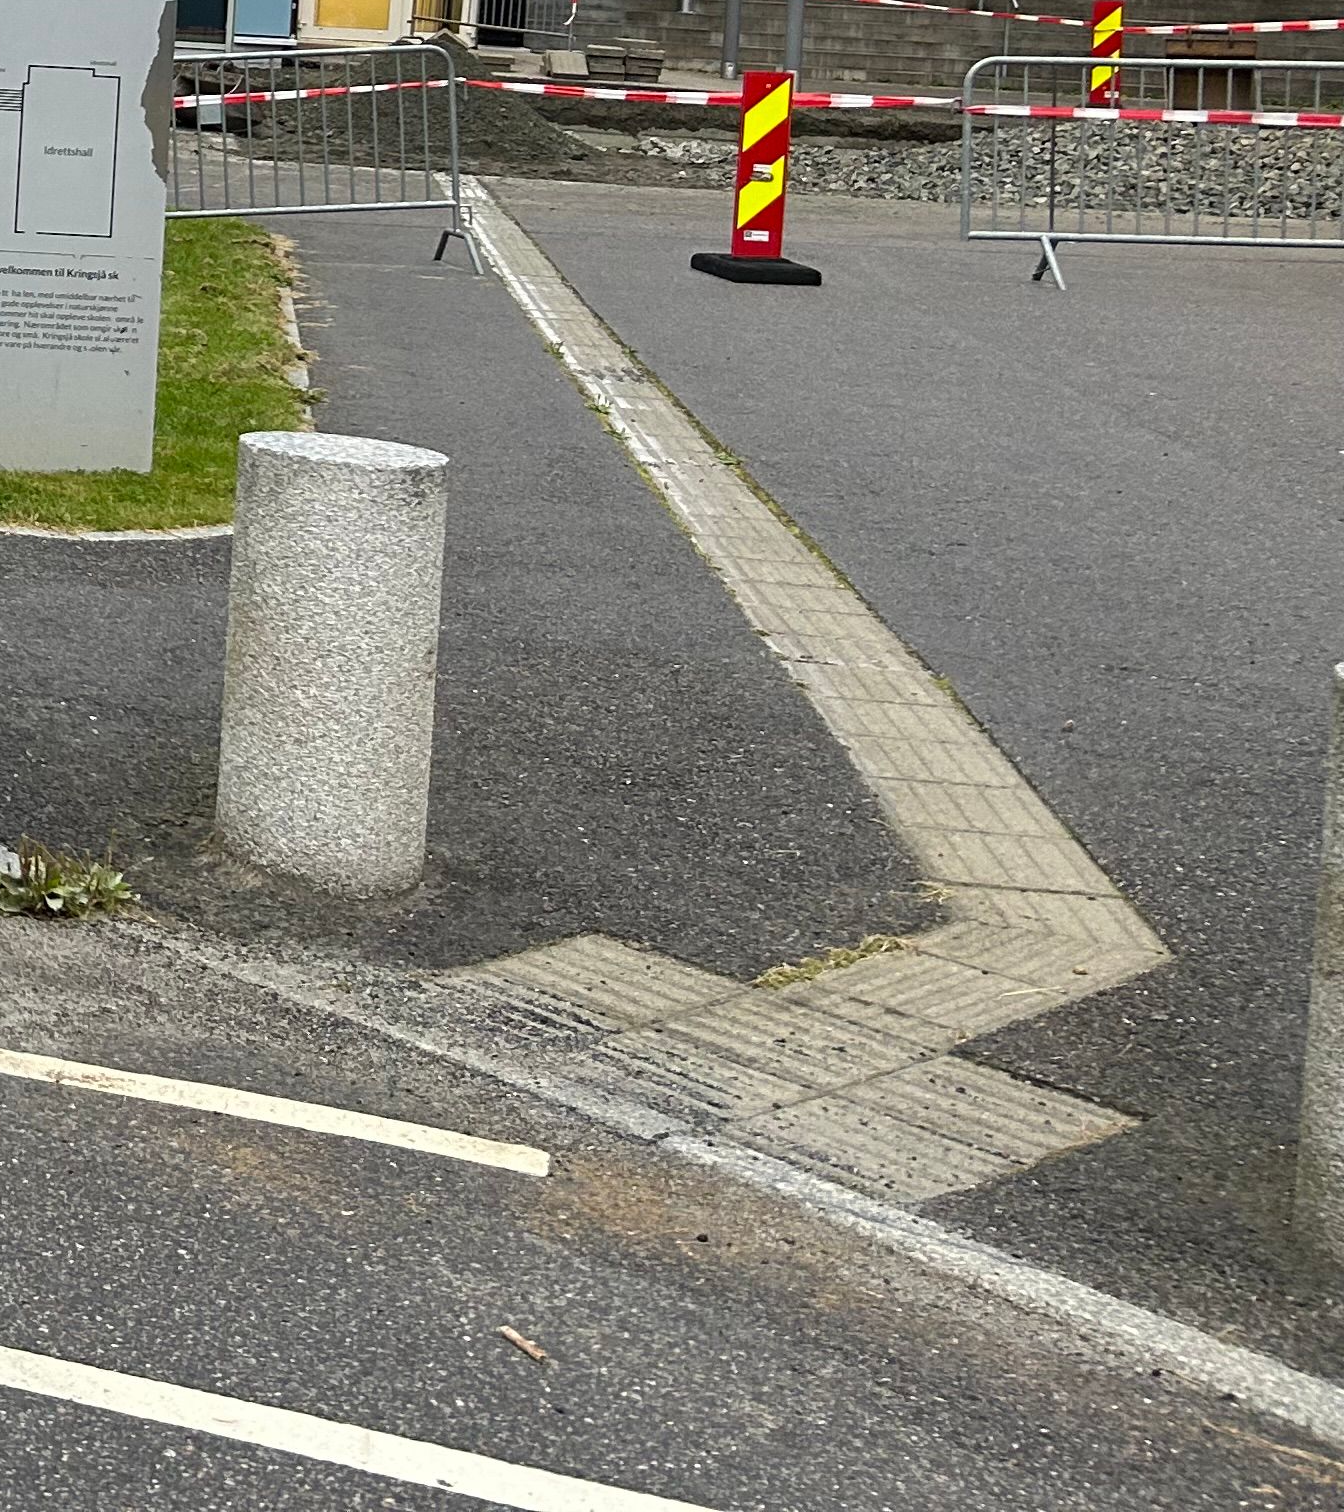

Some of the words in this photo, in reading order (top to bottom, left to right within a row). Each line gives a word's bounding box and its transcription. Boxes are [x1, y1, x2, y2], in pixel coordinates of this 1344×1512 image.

[44, 146, 94, 157] Idrettshall
[55, 267, 65, 277] til
[66, 268, 106, 281] Kringsjå
